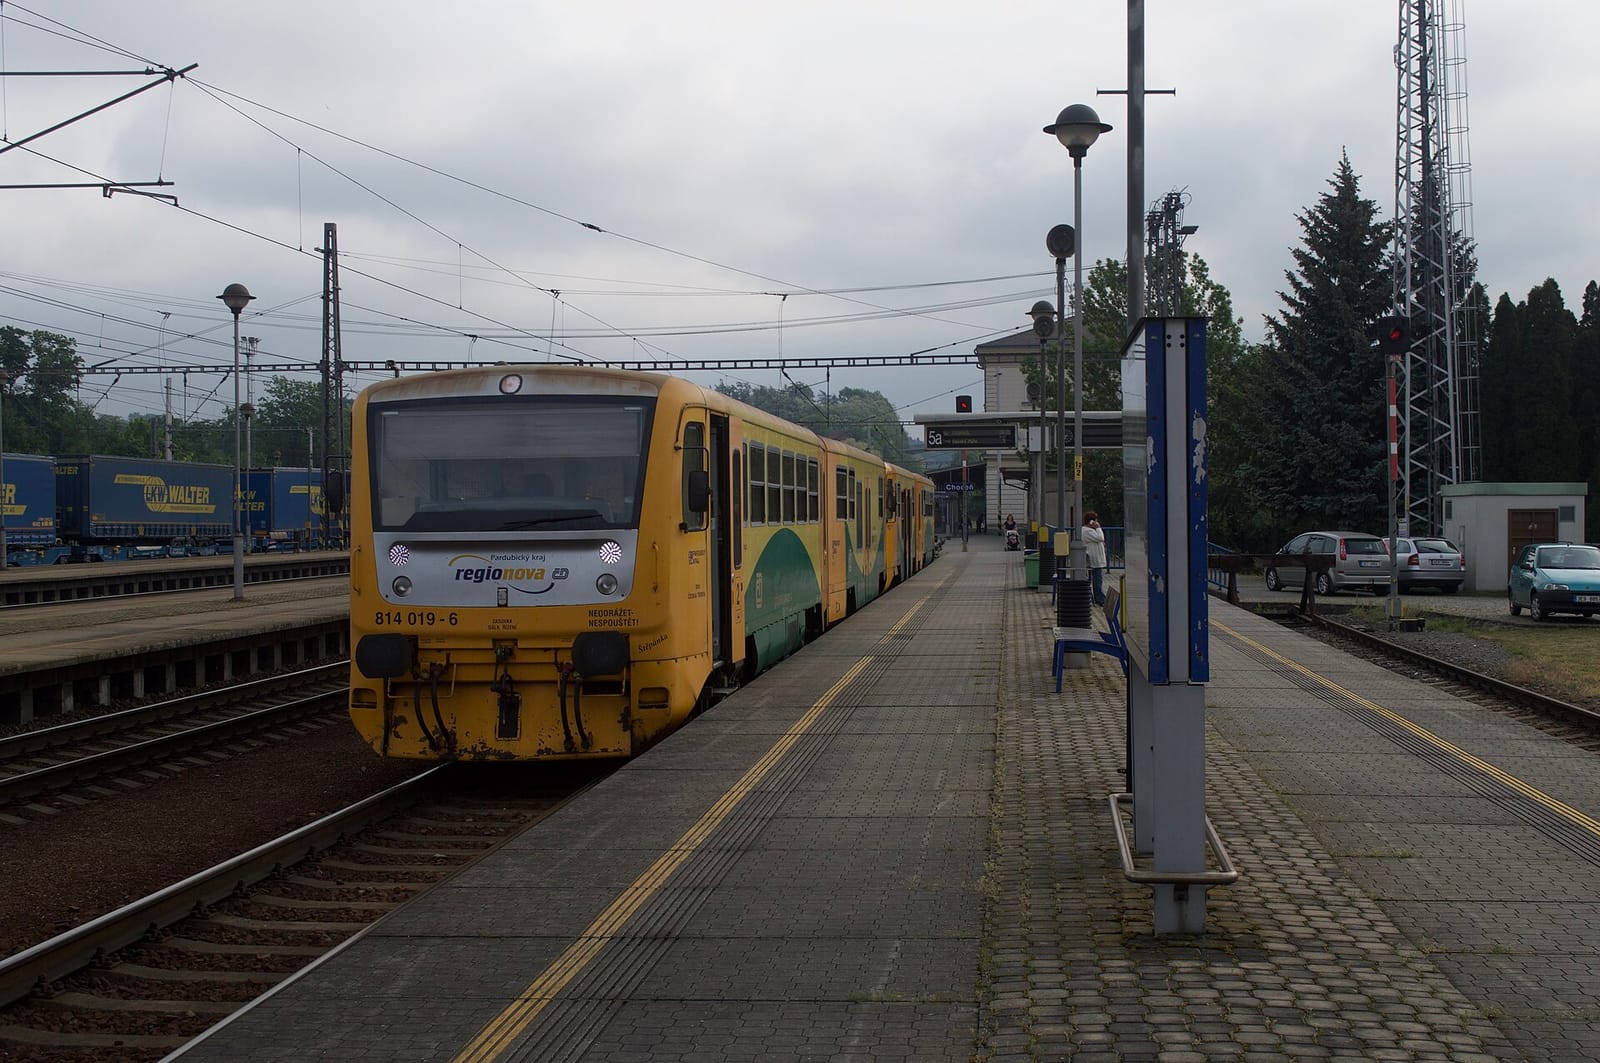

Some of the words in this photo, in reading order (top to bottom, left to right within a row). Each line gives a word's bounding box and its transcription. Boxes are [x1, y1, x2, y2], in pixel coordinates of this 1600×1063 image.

[928, 430, 942, 445] 5a
[55, 466, 78, 474] ALTER
[169, 485, 210, 504] WALTER
[490, 553, 530, 562] Pardubický
[532, 553, 546, 562] kraj
[455, 566, 546, 583] regionova
[375, 611, 402, 625] 814
[408, 612, 435, 626] 019
[449, 612, 458, 626] 6
